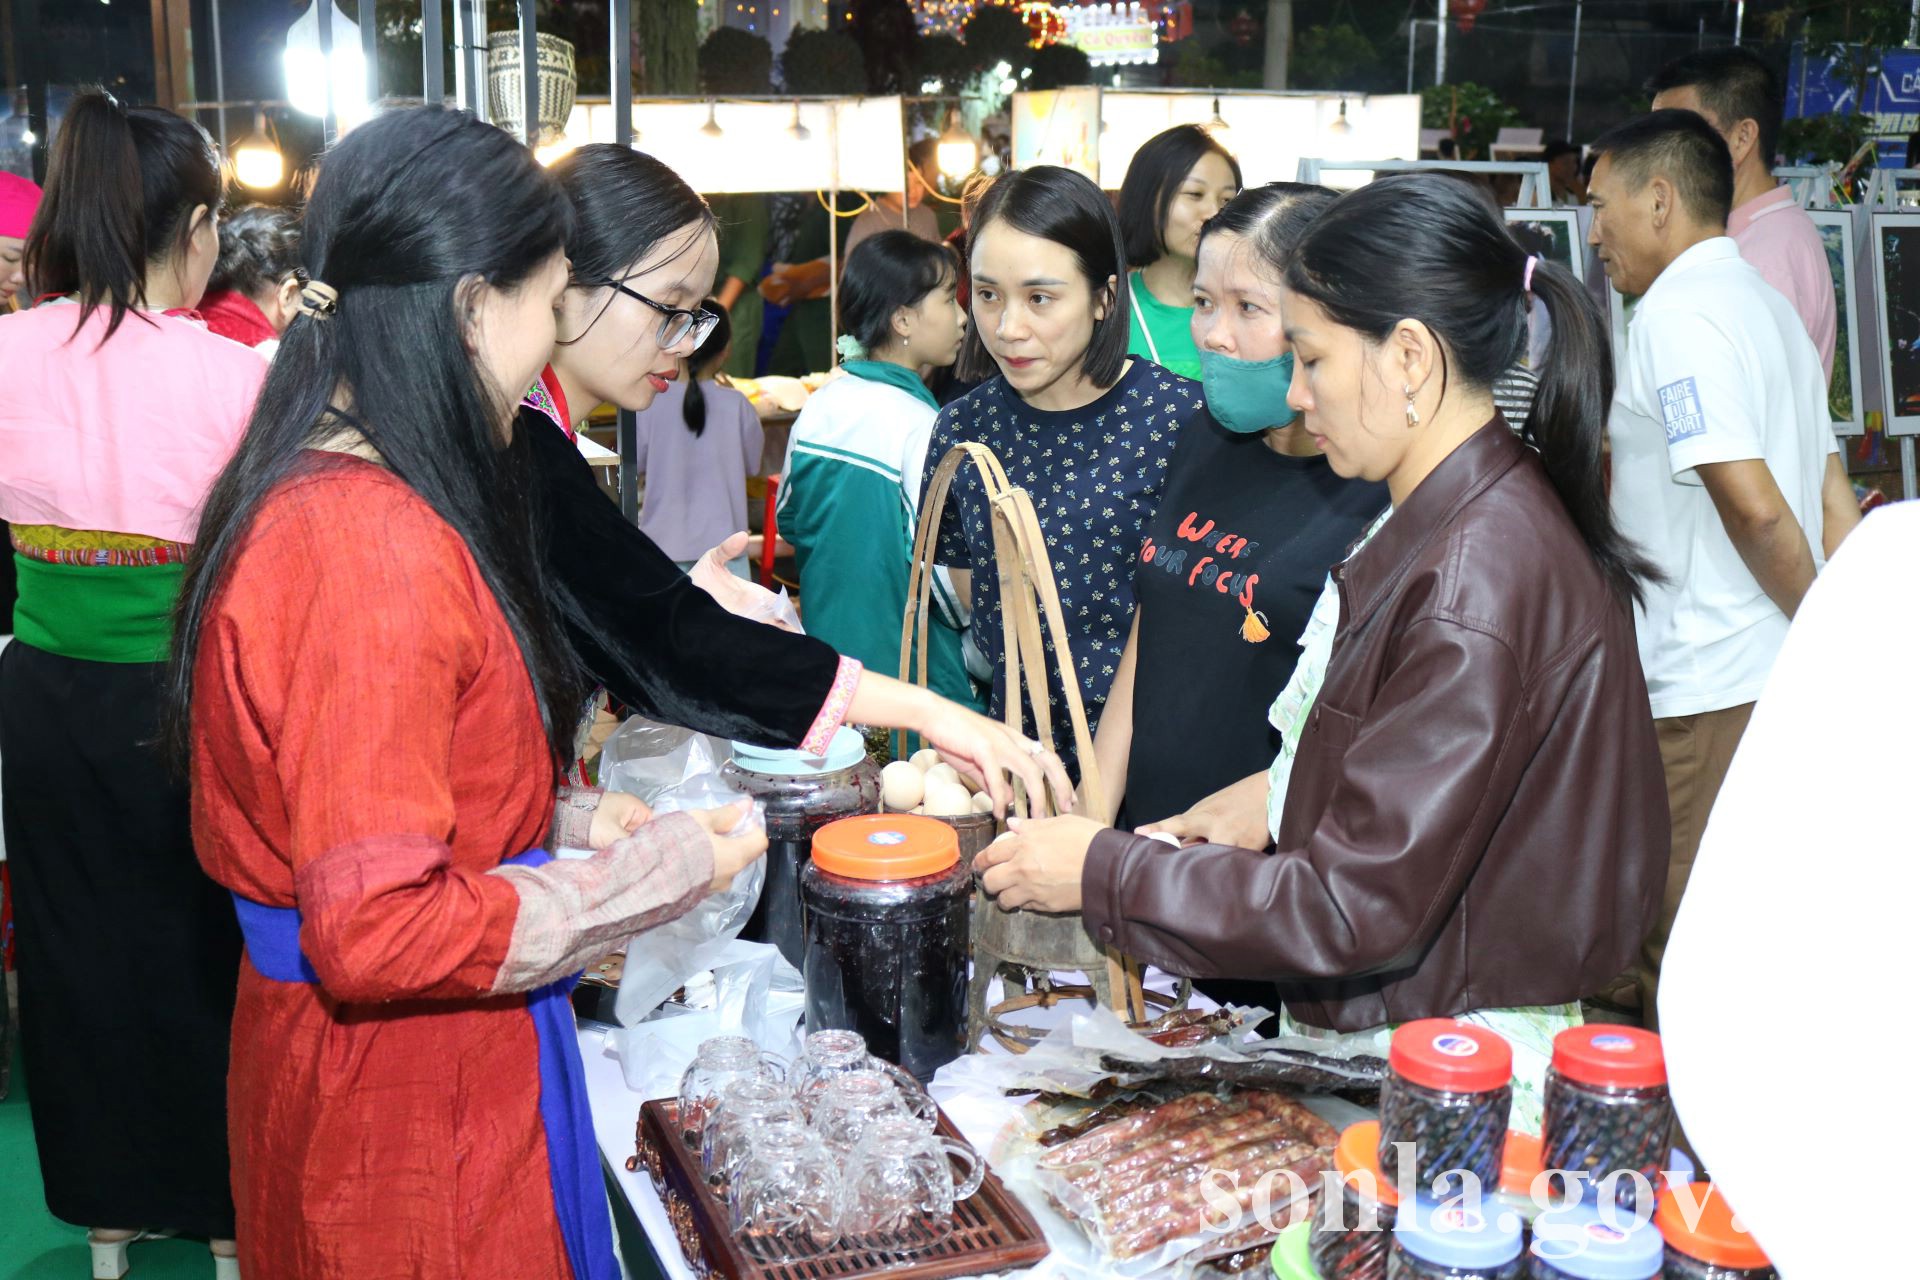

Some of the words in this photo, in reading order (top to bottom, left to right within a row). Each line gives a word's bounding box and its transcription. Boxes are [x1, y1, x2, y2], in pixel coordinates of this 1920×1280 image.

[1660, 380, 1694, 406] FAIRE
[1671, 399, 1687, 419] DU
[1666, 413, 1703, 439] SPORT
[1188, 556, 1259, 608] FOCUS
